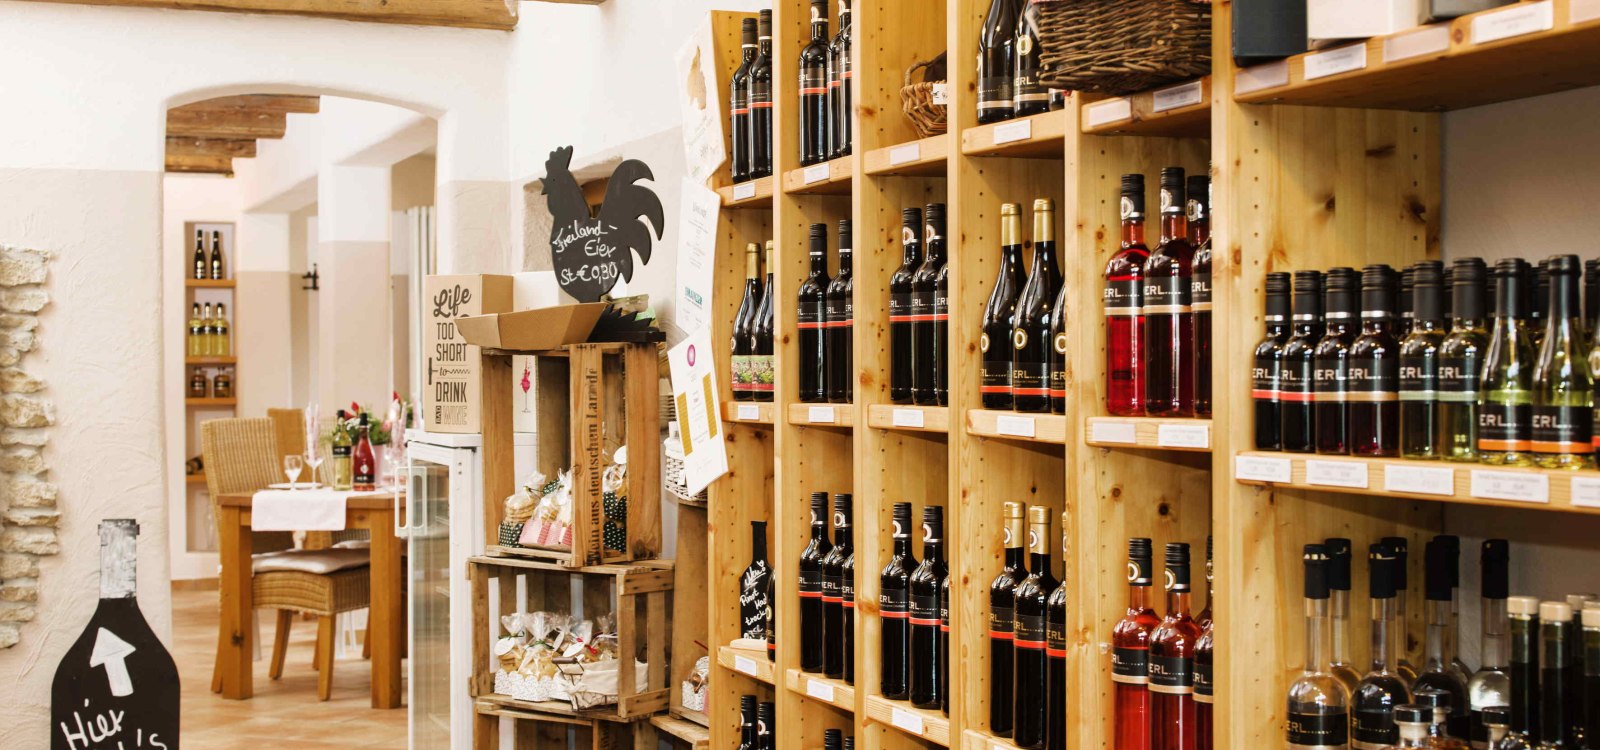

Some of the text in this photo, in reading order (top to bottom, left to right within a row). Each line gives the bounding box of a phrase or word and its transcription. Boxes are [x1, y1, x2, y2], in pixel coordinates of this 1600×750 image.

[584, 237, 617, 258] Eier
[433, 284, 472, 318] Life
[437, 322, 454, 340] TOO
[436, 343, 467, 362] SHORT
[439, 366, 450, 376] to
[435, 381, 467, 403] DRINK
[587, 423, 600, 497] deutschen
[591, 501, 600, 525] aus
